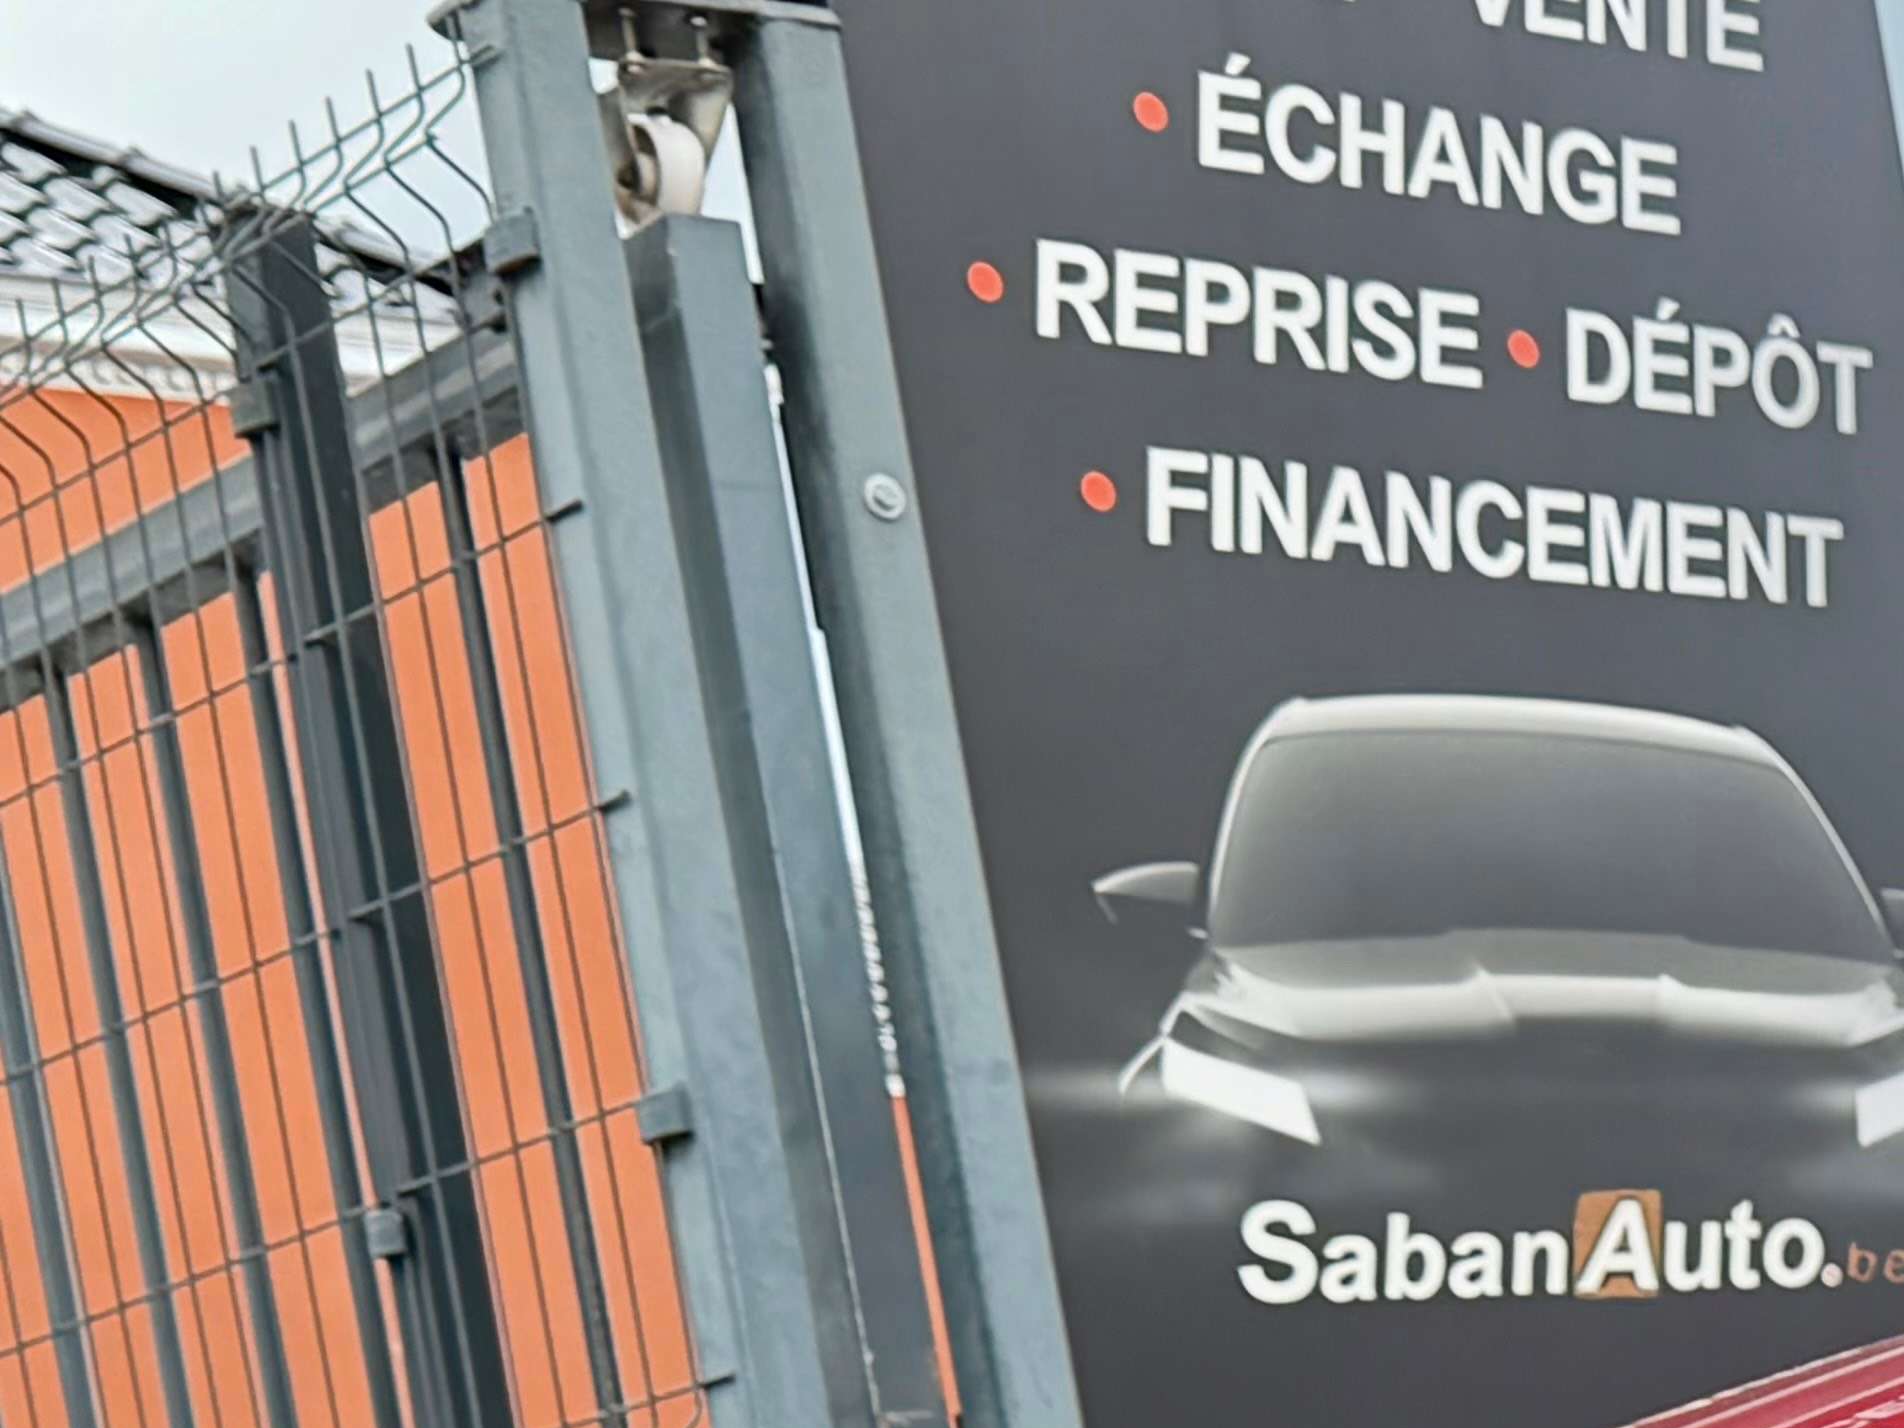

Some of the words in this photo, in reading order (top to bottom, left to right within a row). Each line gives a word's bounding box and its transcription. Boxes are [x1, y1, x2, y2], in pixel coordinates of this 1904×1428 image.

[1474, 0, 1765, 72] NTE
[1196, 55, 1682, 235] ÉCHANGE
[1035, 239, 1485, 392] REPRISE
[1565, 296, 1874, 436] DÉPÔT
[1145, 446, 1845, 610] FINANCEMENT
